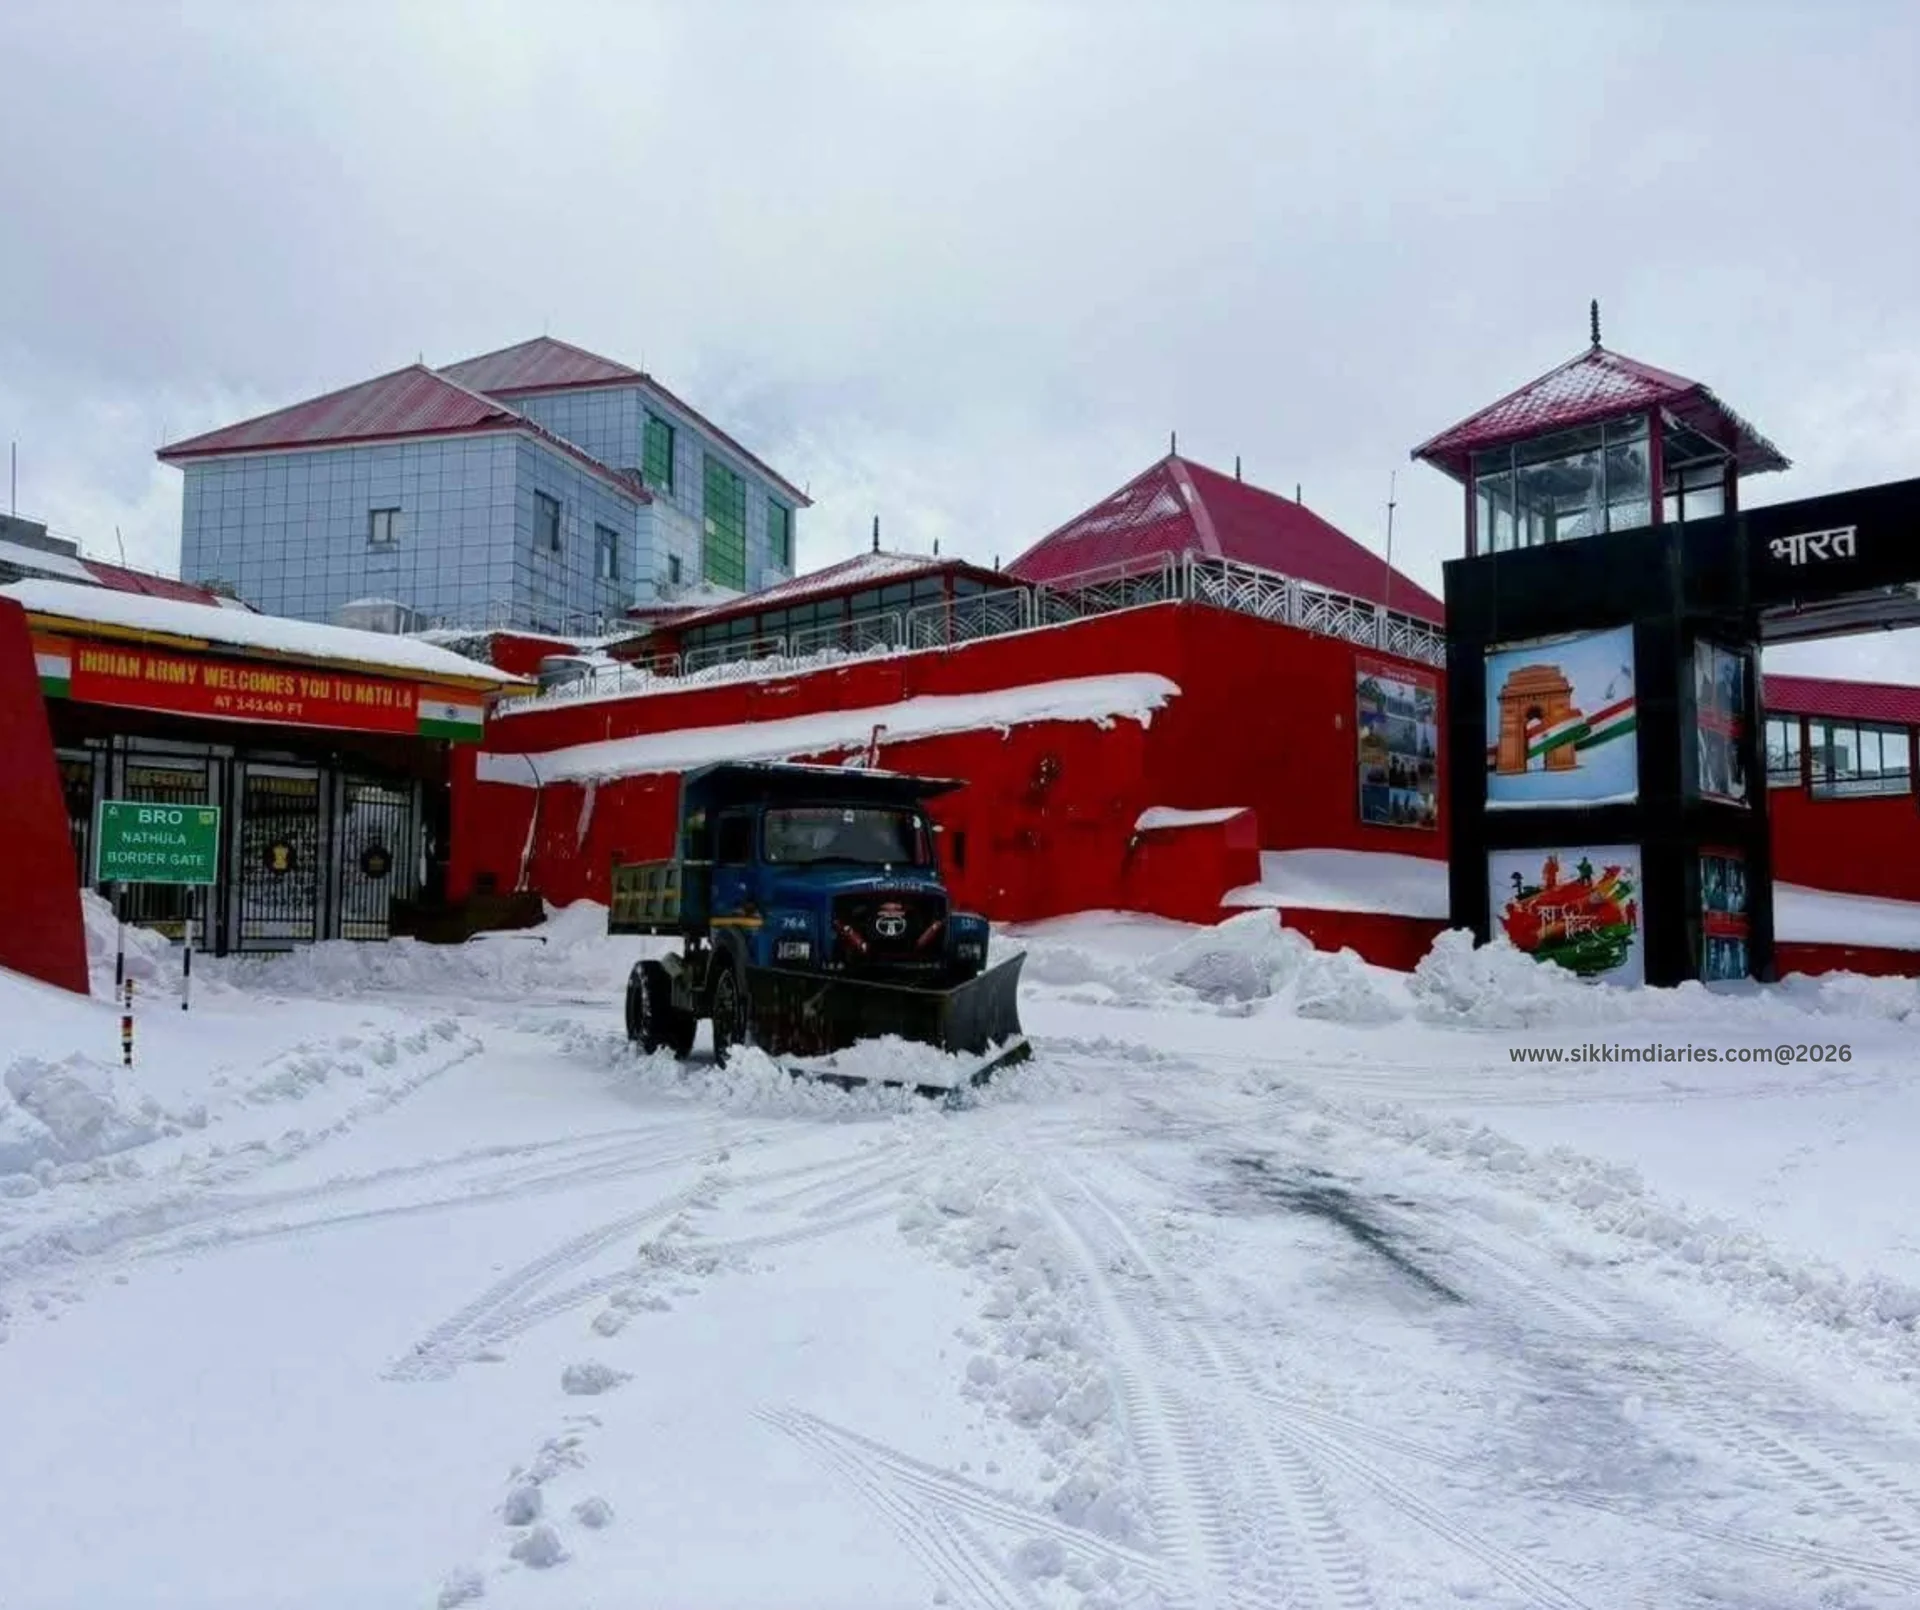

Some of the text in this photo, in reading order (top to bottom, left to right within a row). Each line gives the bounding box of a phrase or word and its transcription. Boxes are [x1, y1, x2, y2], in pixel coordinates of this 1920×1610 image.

[1769, 525, 1858, 566] भारत
[79, 650, 140, 679] INDIAN
[145, 658, 198, 685] ARMY
[203, 665, 296, 696] WELCOMES
[300, 676, 330, 699] YOU
[396, 689, 413, 709] LA
[214, 694, 232, 709] AT
[287, 702, 304, 716] FT
[138, 808, 183, 825] BRO
[121, 831, 187, 846] NATHULA
[107, 851, 206, 866] BORDER GATE
